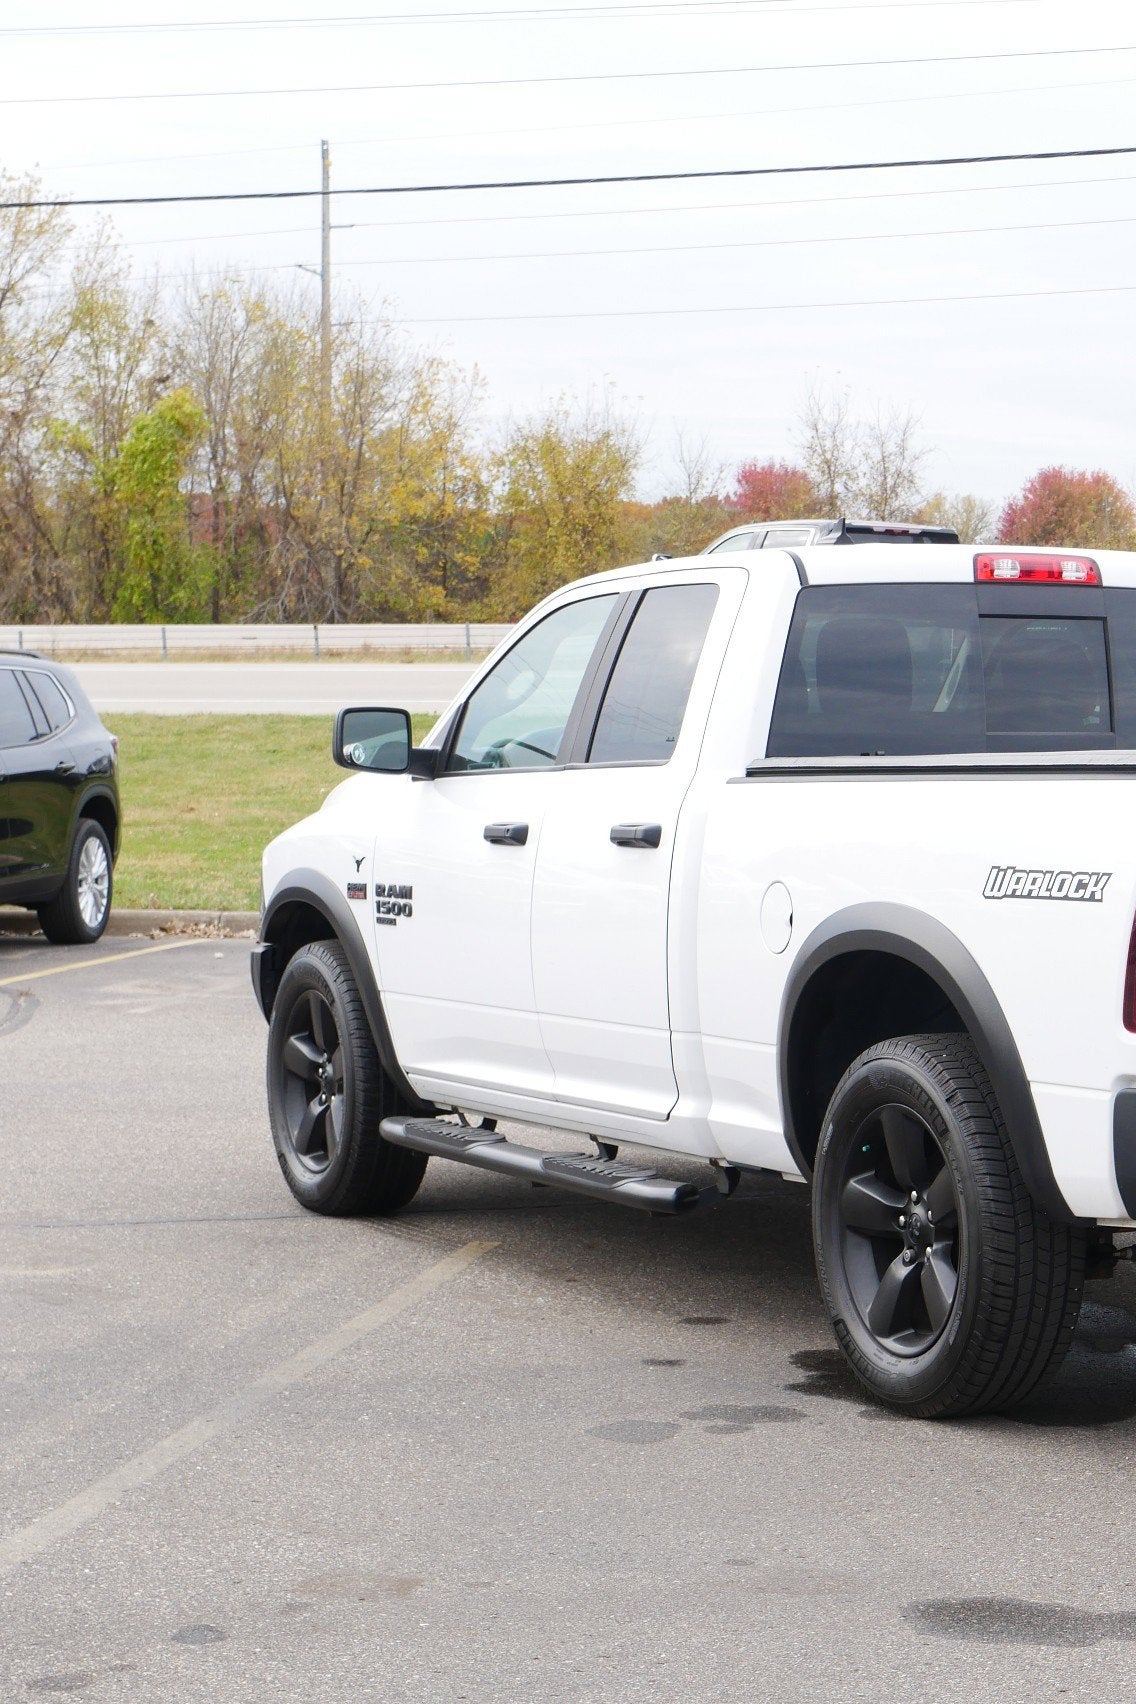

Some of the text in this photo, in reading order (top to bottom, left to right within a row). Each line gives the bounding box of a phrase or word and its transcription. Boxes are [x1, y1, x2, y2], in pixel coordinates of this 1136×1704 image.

[375, 883, 413, 900] RAM
[982, 866, 1113, 902] WARLOCK
[375, 900, 413, 917] 1500
